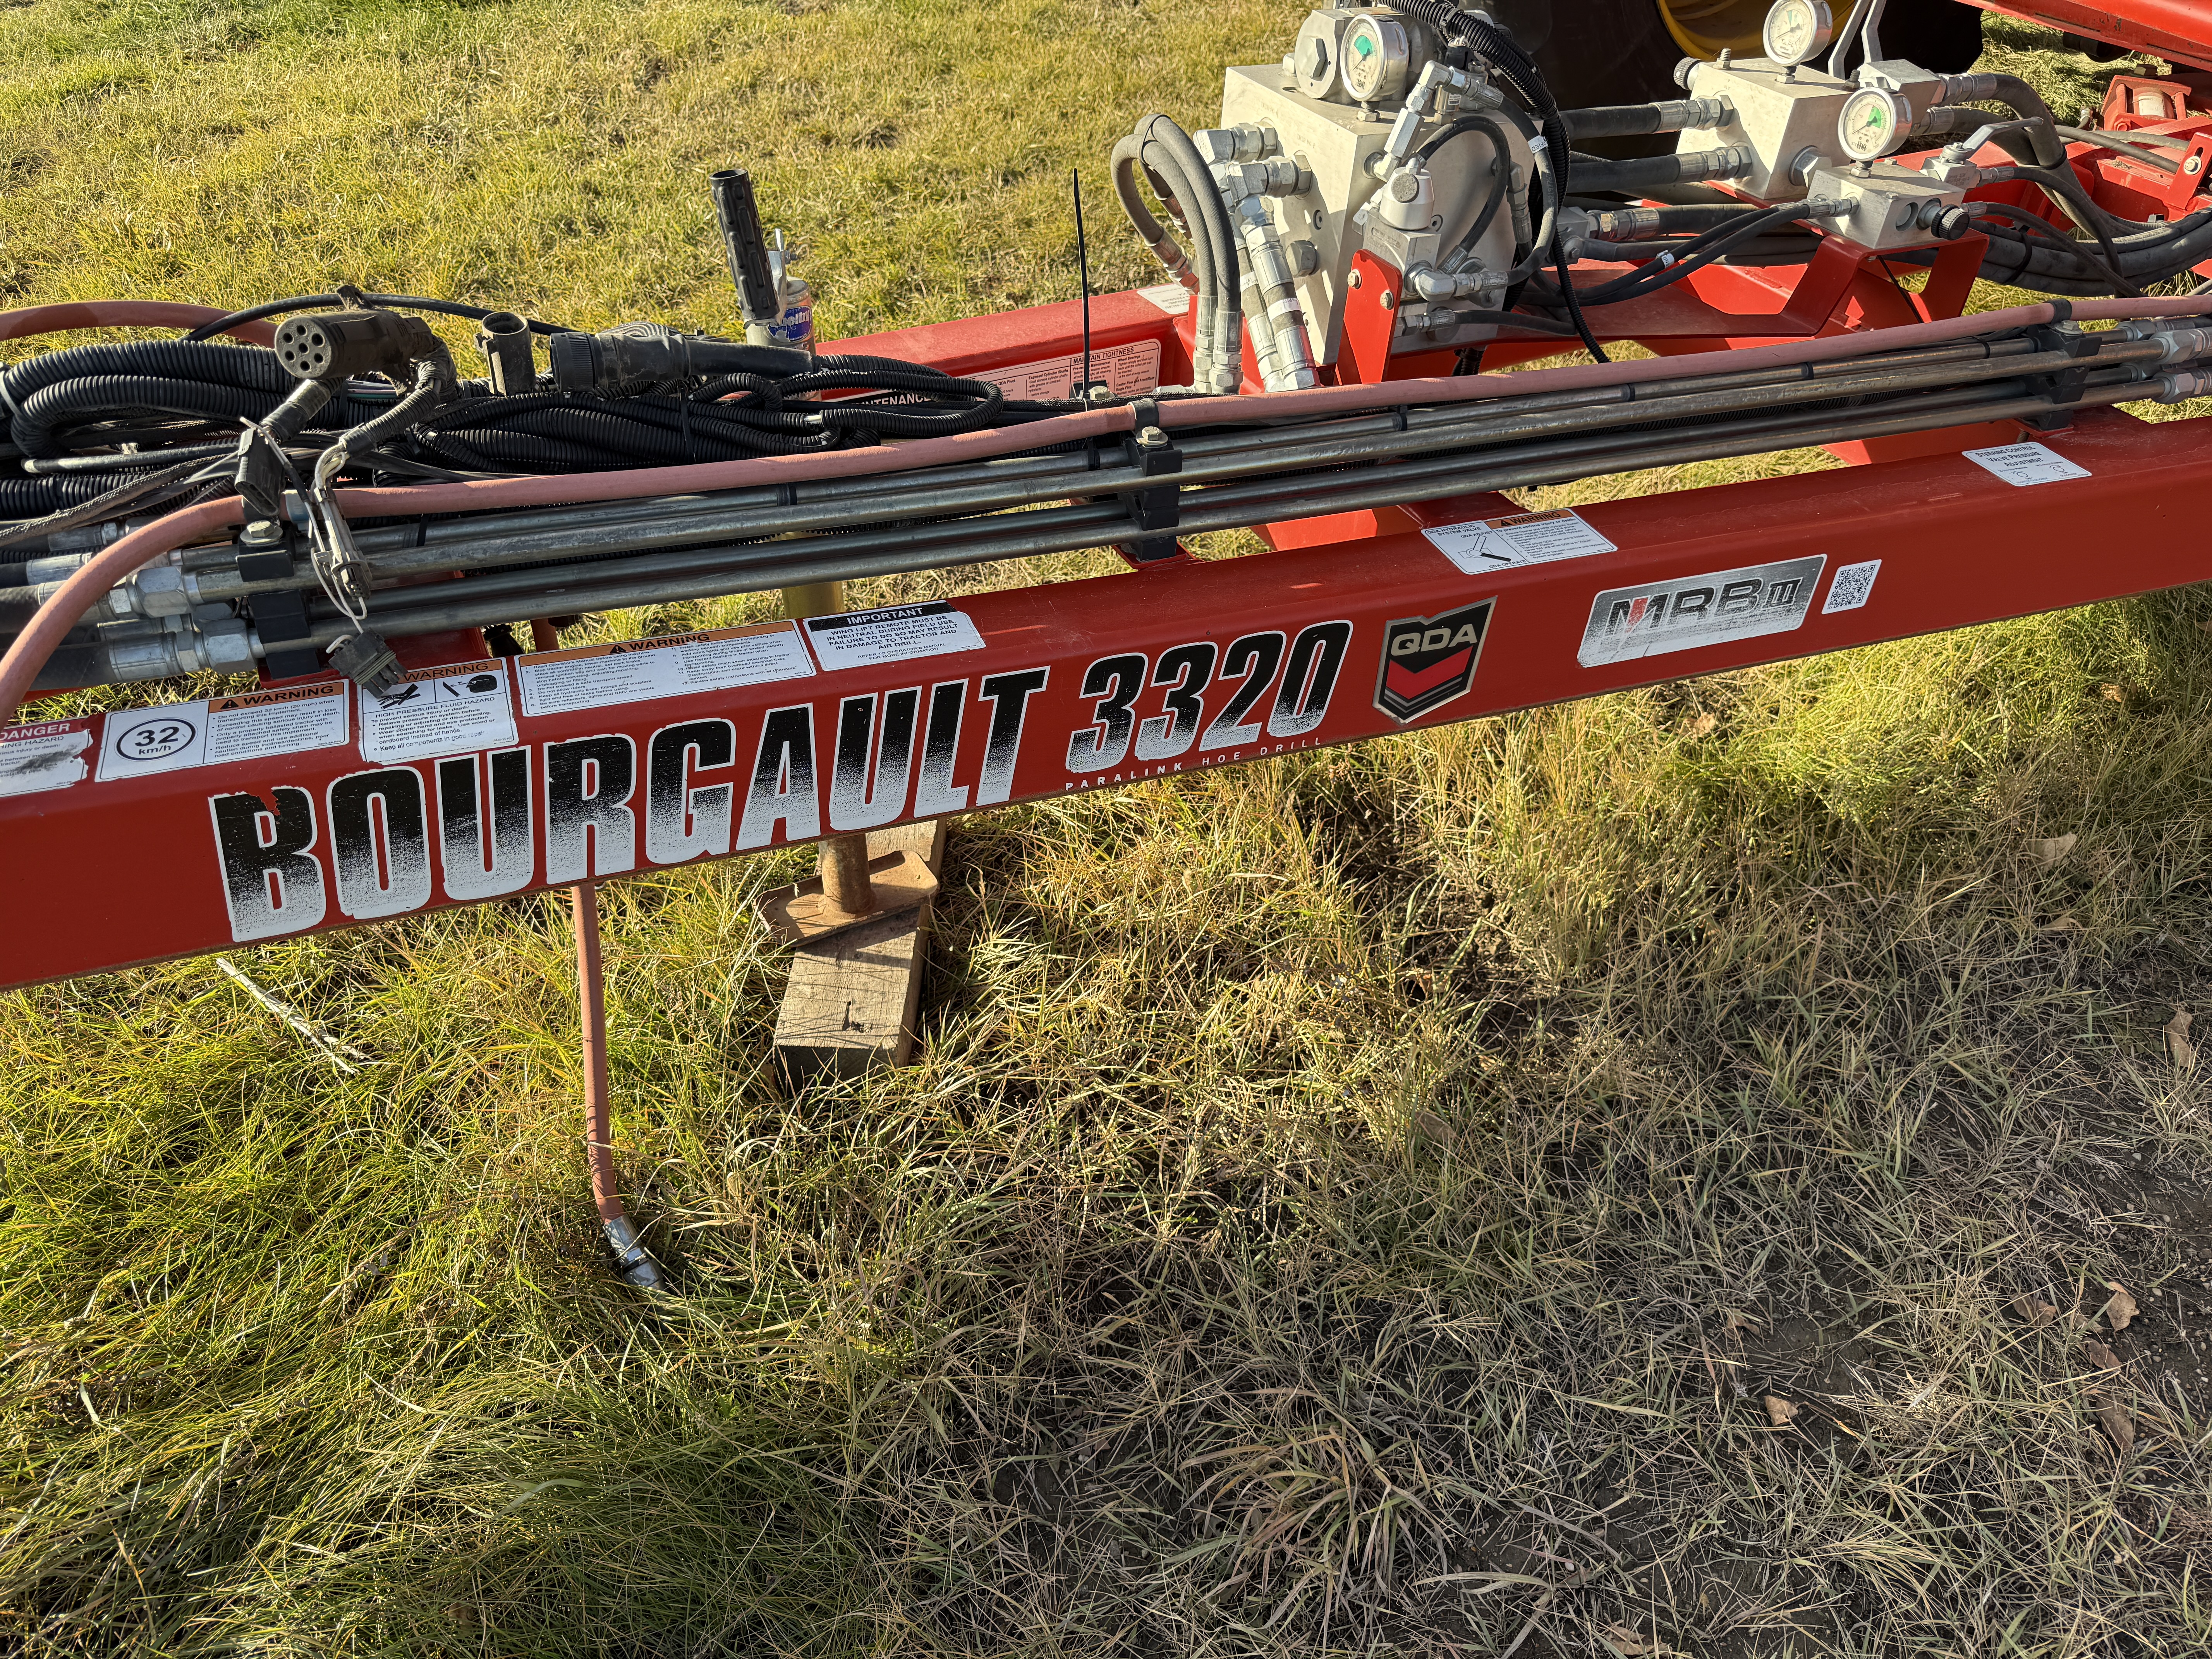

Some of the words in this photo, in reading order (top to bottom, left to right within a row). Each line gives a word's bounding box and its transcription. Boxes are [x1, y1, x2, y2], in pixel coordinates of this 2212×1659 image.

[1102, 347, 1134, 359] TIGHTNESS
[2003, 457, 2044, 467] ADJUSTMENT
[2007, 451, 2042, 459] PRESSURE
[1509, 512, 1561, 524] WARNING
[1602, 577, 1764, 638] MRB
[847, 607, 922, 624] IMPORTANT
[874, 620, 910, 629] REMOTE
[828, 637, 865, 646] FAILURE
[927, 623, 957, 632] RESULT
[836, 630, 877, 639] NEUTRAL
[878, 625, 910, 634] DURING
[628, 634, 710, 650] WARNING
[845, 639, 883, 649] DAMAGE
[897, 632, 939, 641] TRACTOR
[1391, 623, 1477, 656] QDA
[404, 662, 488, 681] WARNING
[243, 685, 333, 705] WARNING
[217, 714, 254, 723] transporting
[268, 708, 302, 716] implement.
[396, 705, 438, 715] PRESSURE
[449, 711, 491, 720] disconnecting.
[459, 715, 488, 723] protection
[25, 736, 64, 745] HAZARD
[135, 726, 180, 747] 32
[378, 735, 409, 744] cardboard
[139, 745, 171, 755] km/h
[1066, 762, 1182, 790] PARALINK
[1202, 752, 1241, 766] HOE
[1261, 737, 1321, 756] DRILL
[208, 666, 1051, 942] BOURGAULT
[1065, 620, 1353, 773] 3320
